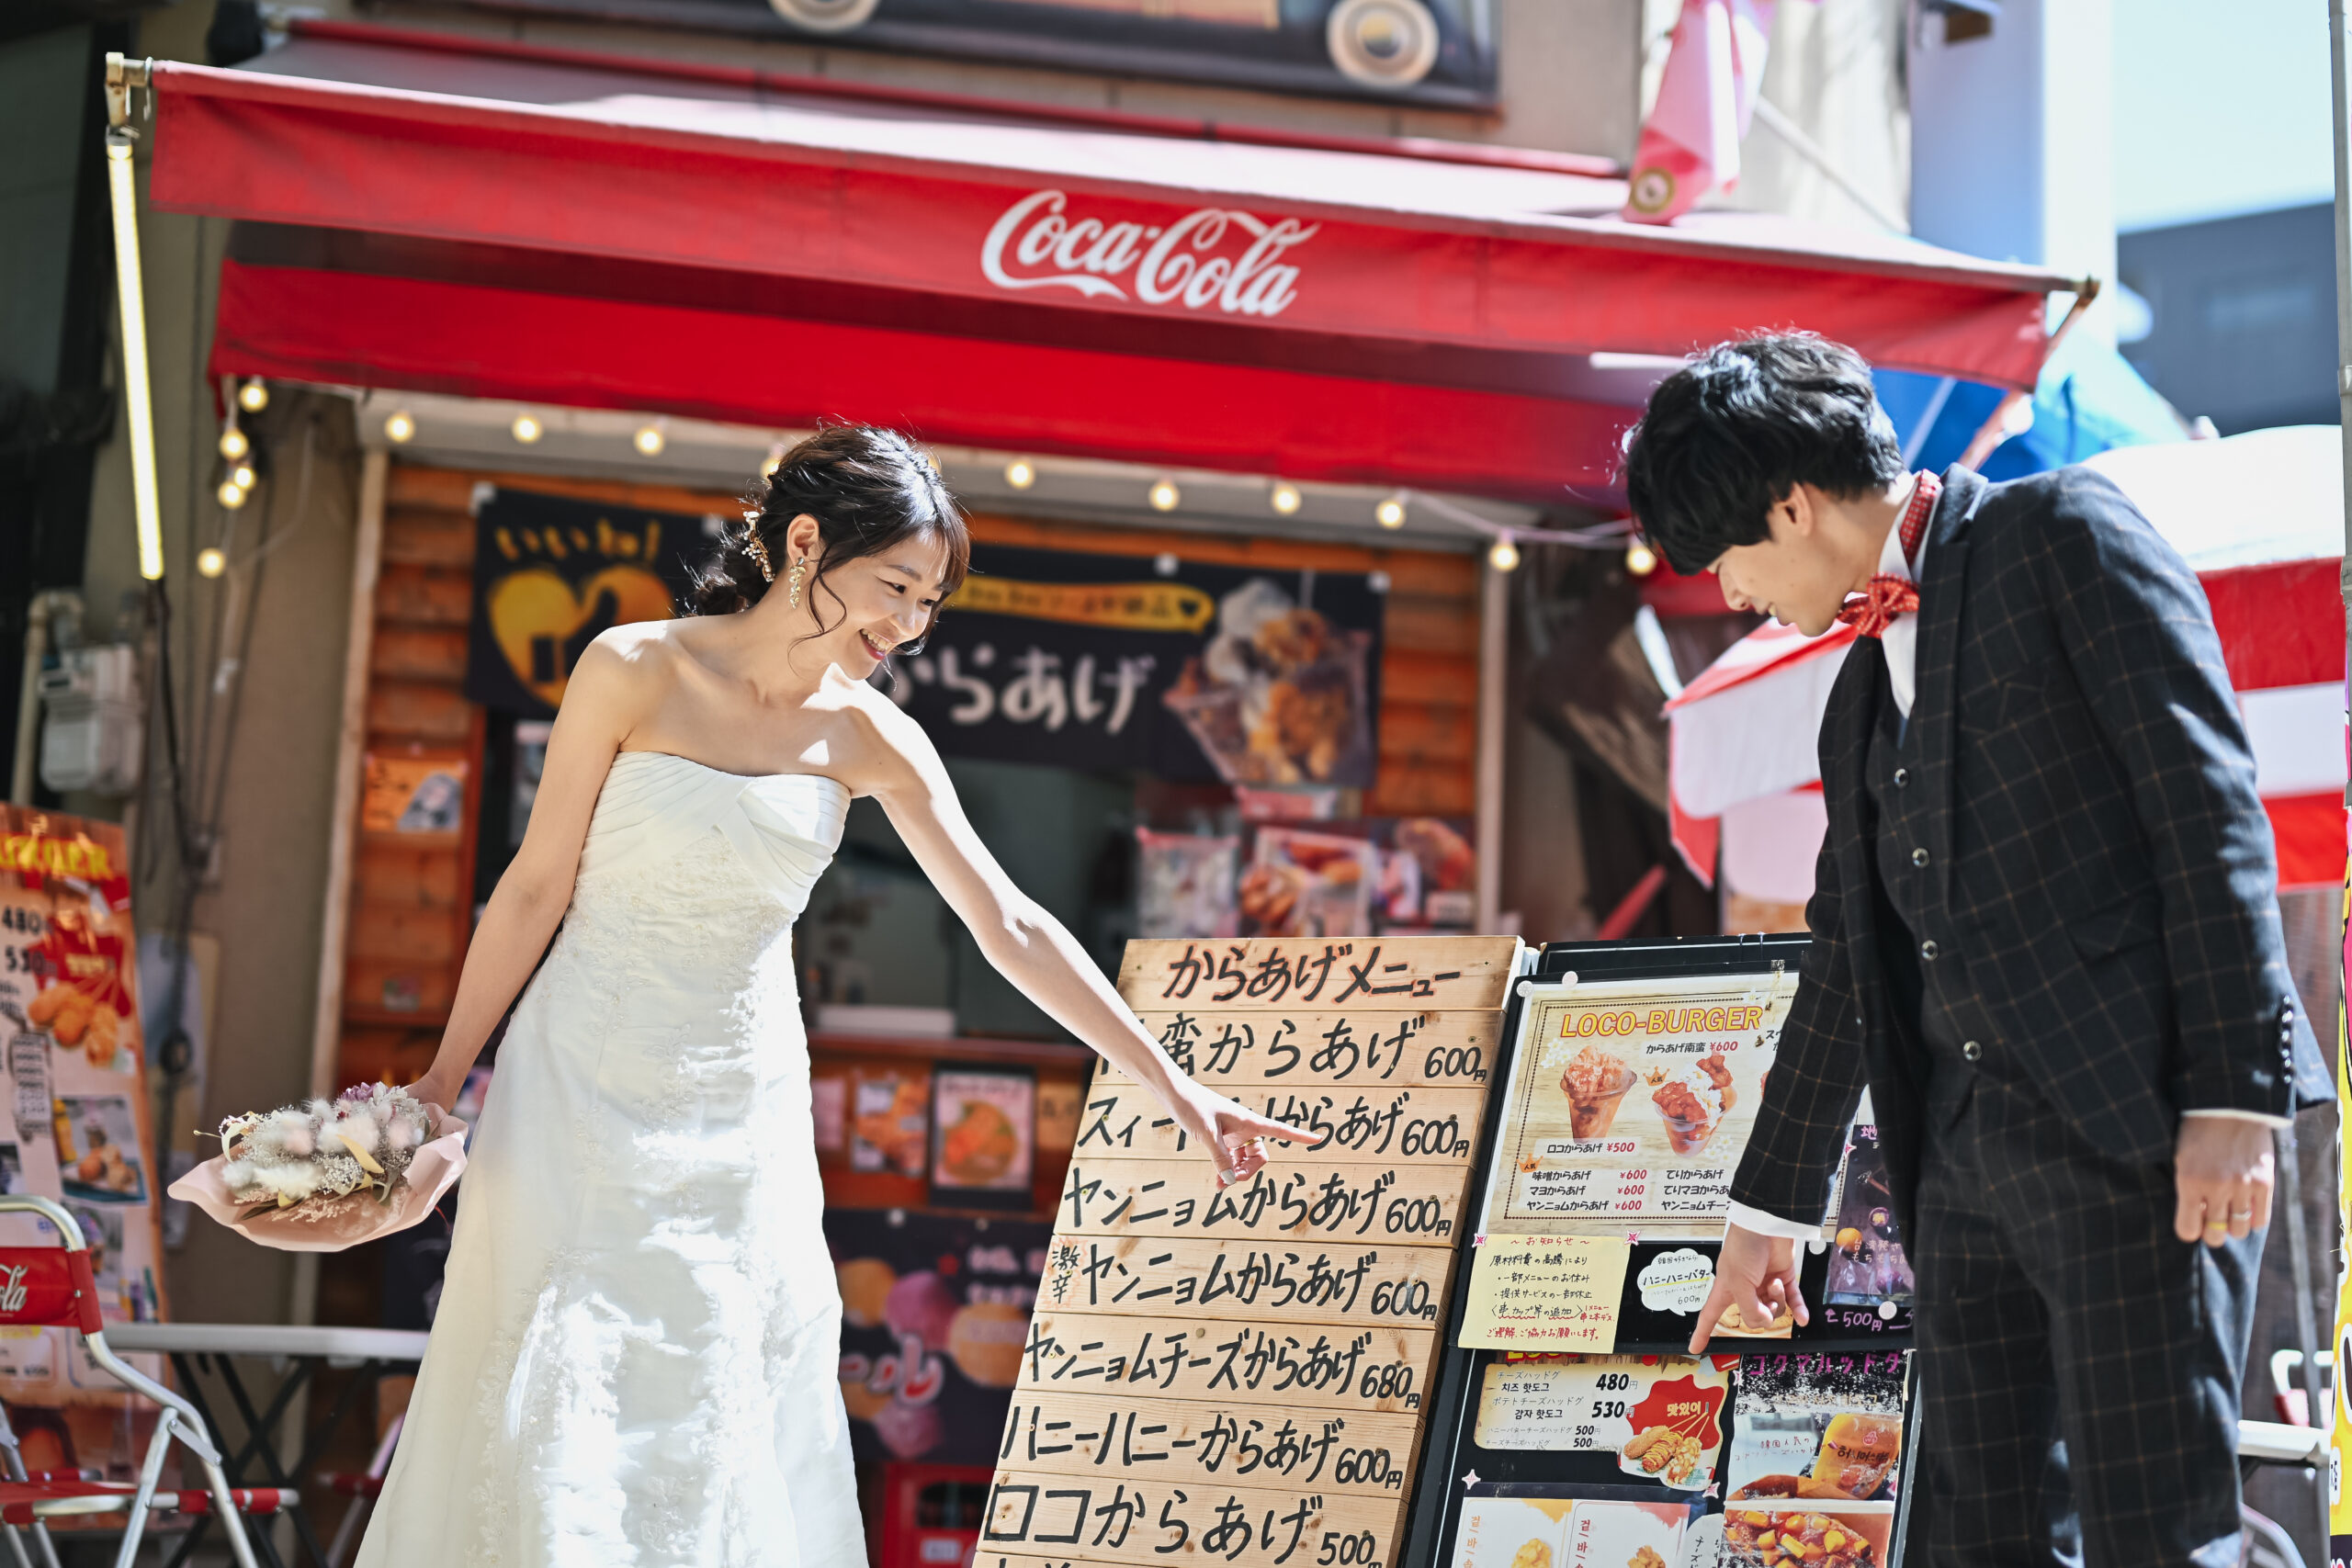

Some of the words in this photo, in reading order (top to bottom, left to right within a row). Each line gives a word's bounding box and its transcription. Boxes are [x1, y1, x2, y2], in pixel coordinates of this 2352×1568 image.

[1161, 943, 1462, 1004] からあげメニュー
[1560, 1005, 1763, 1039] LOCO-BURGER
[1100, 1012, 1425, 1079] 蛮からあげ
[1424, 1045, 1487, 1082] 600円
[1645, 1043, 1706, 1055] からあげ南蛮
[1710, 1041, 1738, 1052] ¥600
[1401, 1118, 1469, 1158] 600円
[1546, 1143, 1603, 1154] ロコからあげ
[1607, 1142, 1634, 1153] ¥500
[1532, 1170, 1591, 1181] 味噌からあげ
[1620, 1169, 1647, 1180] ¥600
[1666, 1168, 1724, 1180] てりからあげ
[1530, 1185, 1587, 1196] マヨからあげ
[1617, 1185, 1645, 1196] ¥600
[1065, 1168, 1396, 1235] ヤンニョムからあげ
[1385, 1197, 1452, 1237] 600円
[1526, 1200, 1610, 1212] ヤンニョムからあげ
[1615, 1200, 1642, 1211] ¥600
[1052, 1245, 1081, 1304] 激辛
[1081, 1243, 1377, 1313] ヤンニョムからあげ
[1371, 1280, 1438, 1321] 600円
[1643, 1269, 1711, 1286] ハニーハニーバター
[1843, 1311, 1883, 1331] 500円
[1024, 1324, 1374, 1396] ヤンニョムチーズからあげ
[1360, 1363, 1420, 1408] 680円
[1497, 1370, 1561, 1380] チーズハッドグ
[1596, 1373, 1638, 1391] 480円
[1501, 1382, 1520, 1392] 치즈
[1523, 1382, 1550, 1393] 핫도그
[1515, 1409, 1533, 1420] 감자
[1536, 1409, 1563, 1420] 핫도그
[1591, 1401, 1634, 1418] 530円
[1001, 1405, 1345, 1483] ハニーハニーからあげ
[1335, 1448, 1403, 1489] 600円
[982, 1483, 1323, 1565] ロコからあげ
